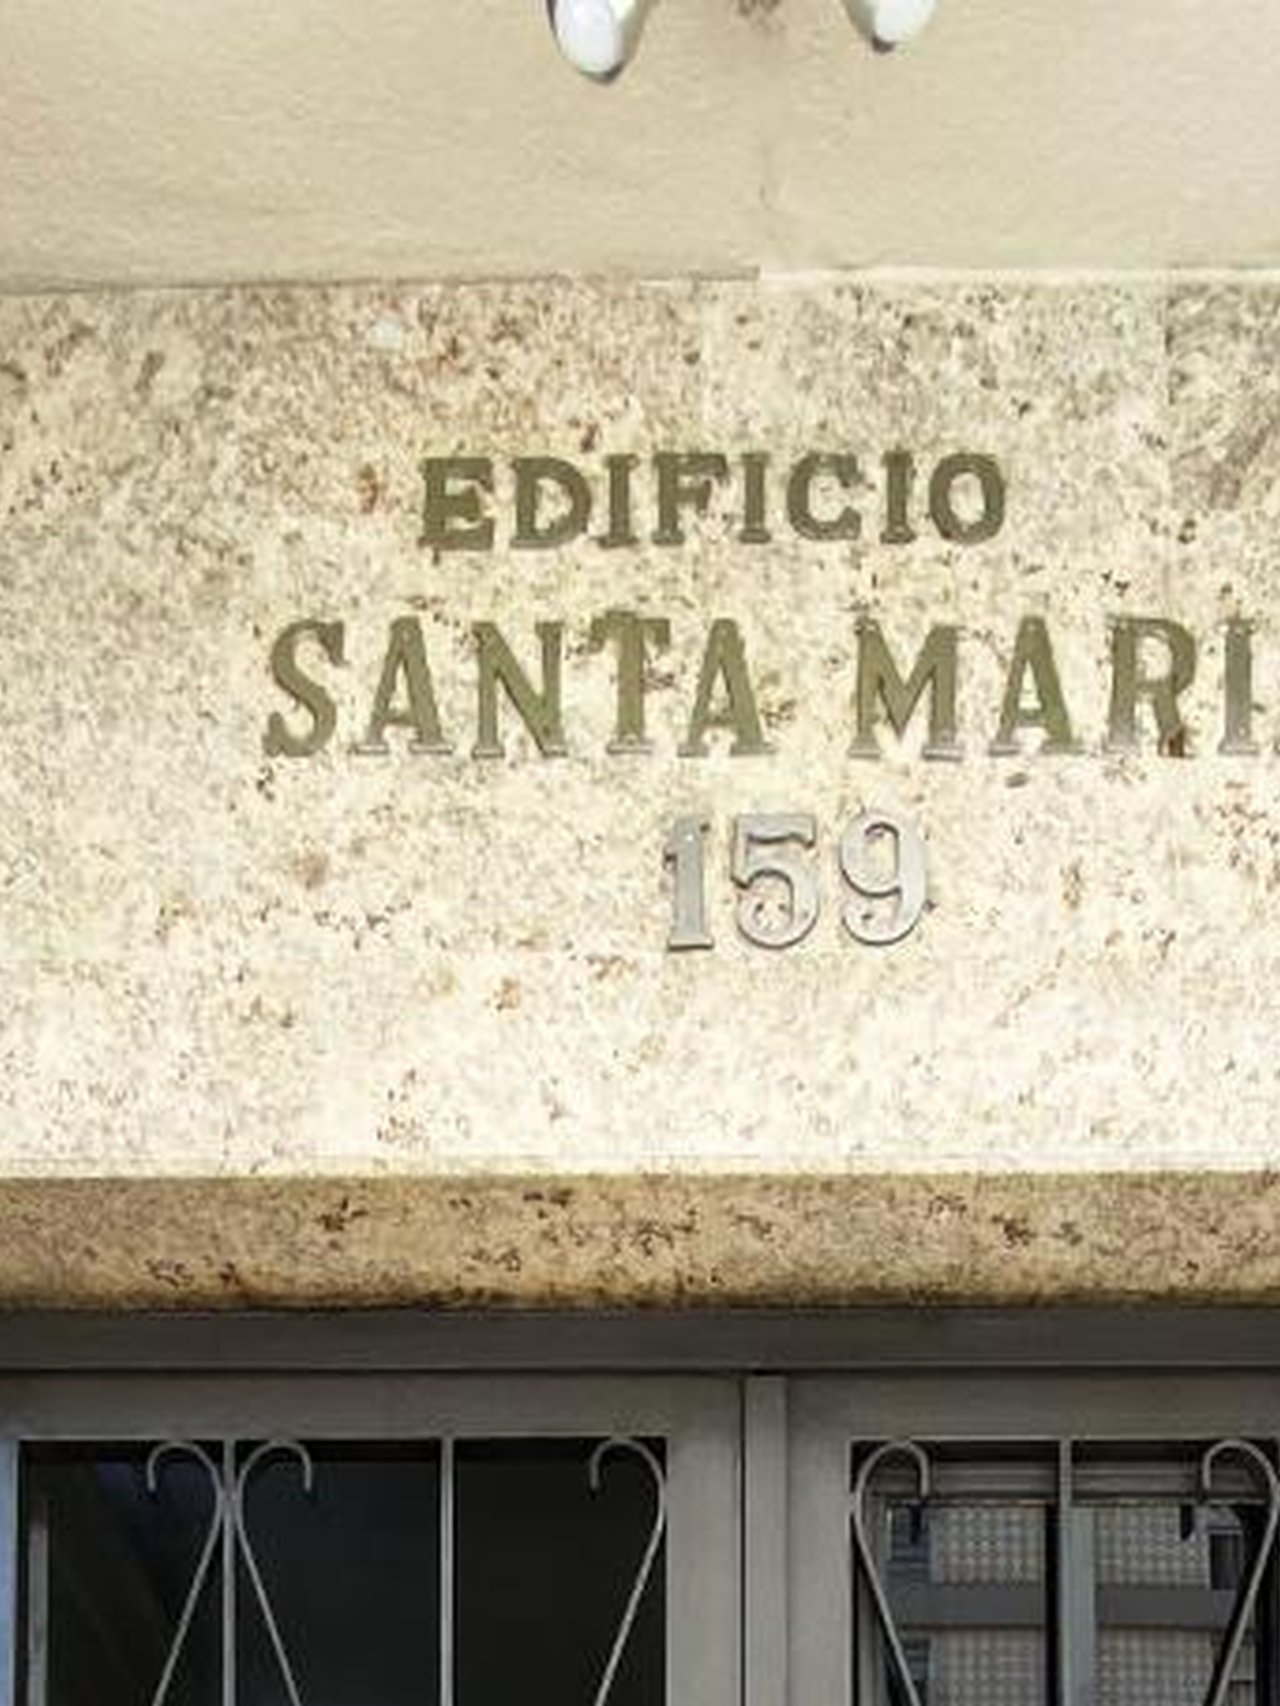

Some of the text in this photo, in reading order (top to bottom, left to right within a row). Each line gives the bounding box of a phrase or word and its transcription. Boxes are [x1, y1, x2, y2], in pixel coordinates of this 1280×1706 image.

[417, 448, 1008, 551] EDIFICIO
[260, 611, 773, 761] SANTA
[662, 811, 933, 953] 159
